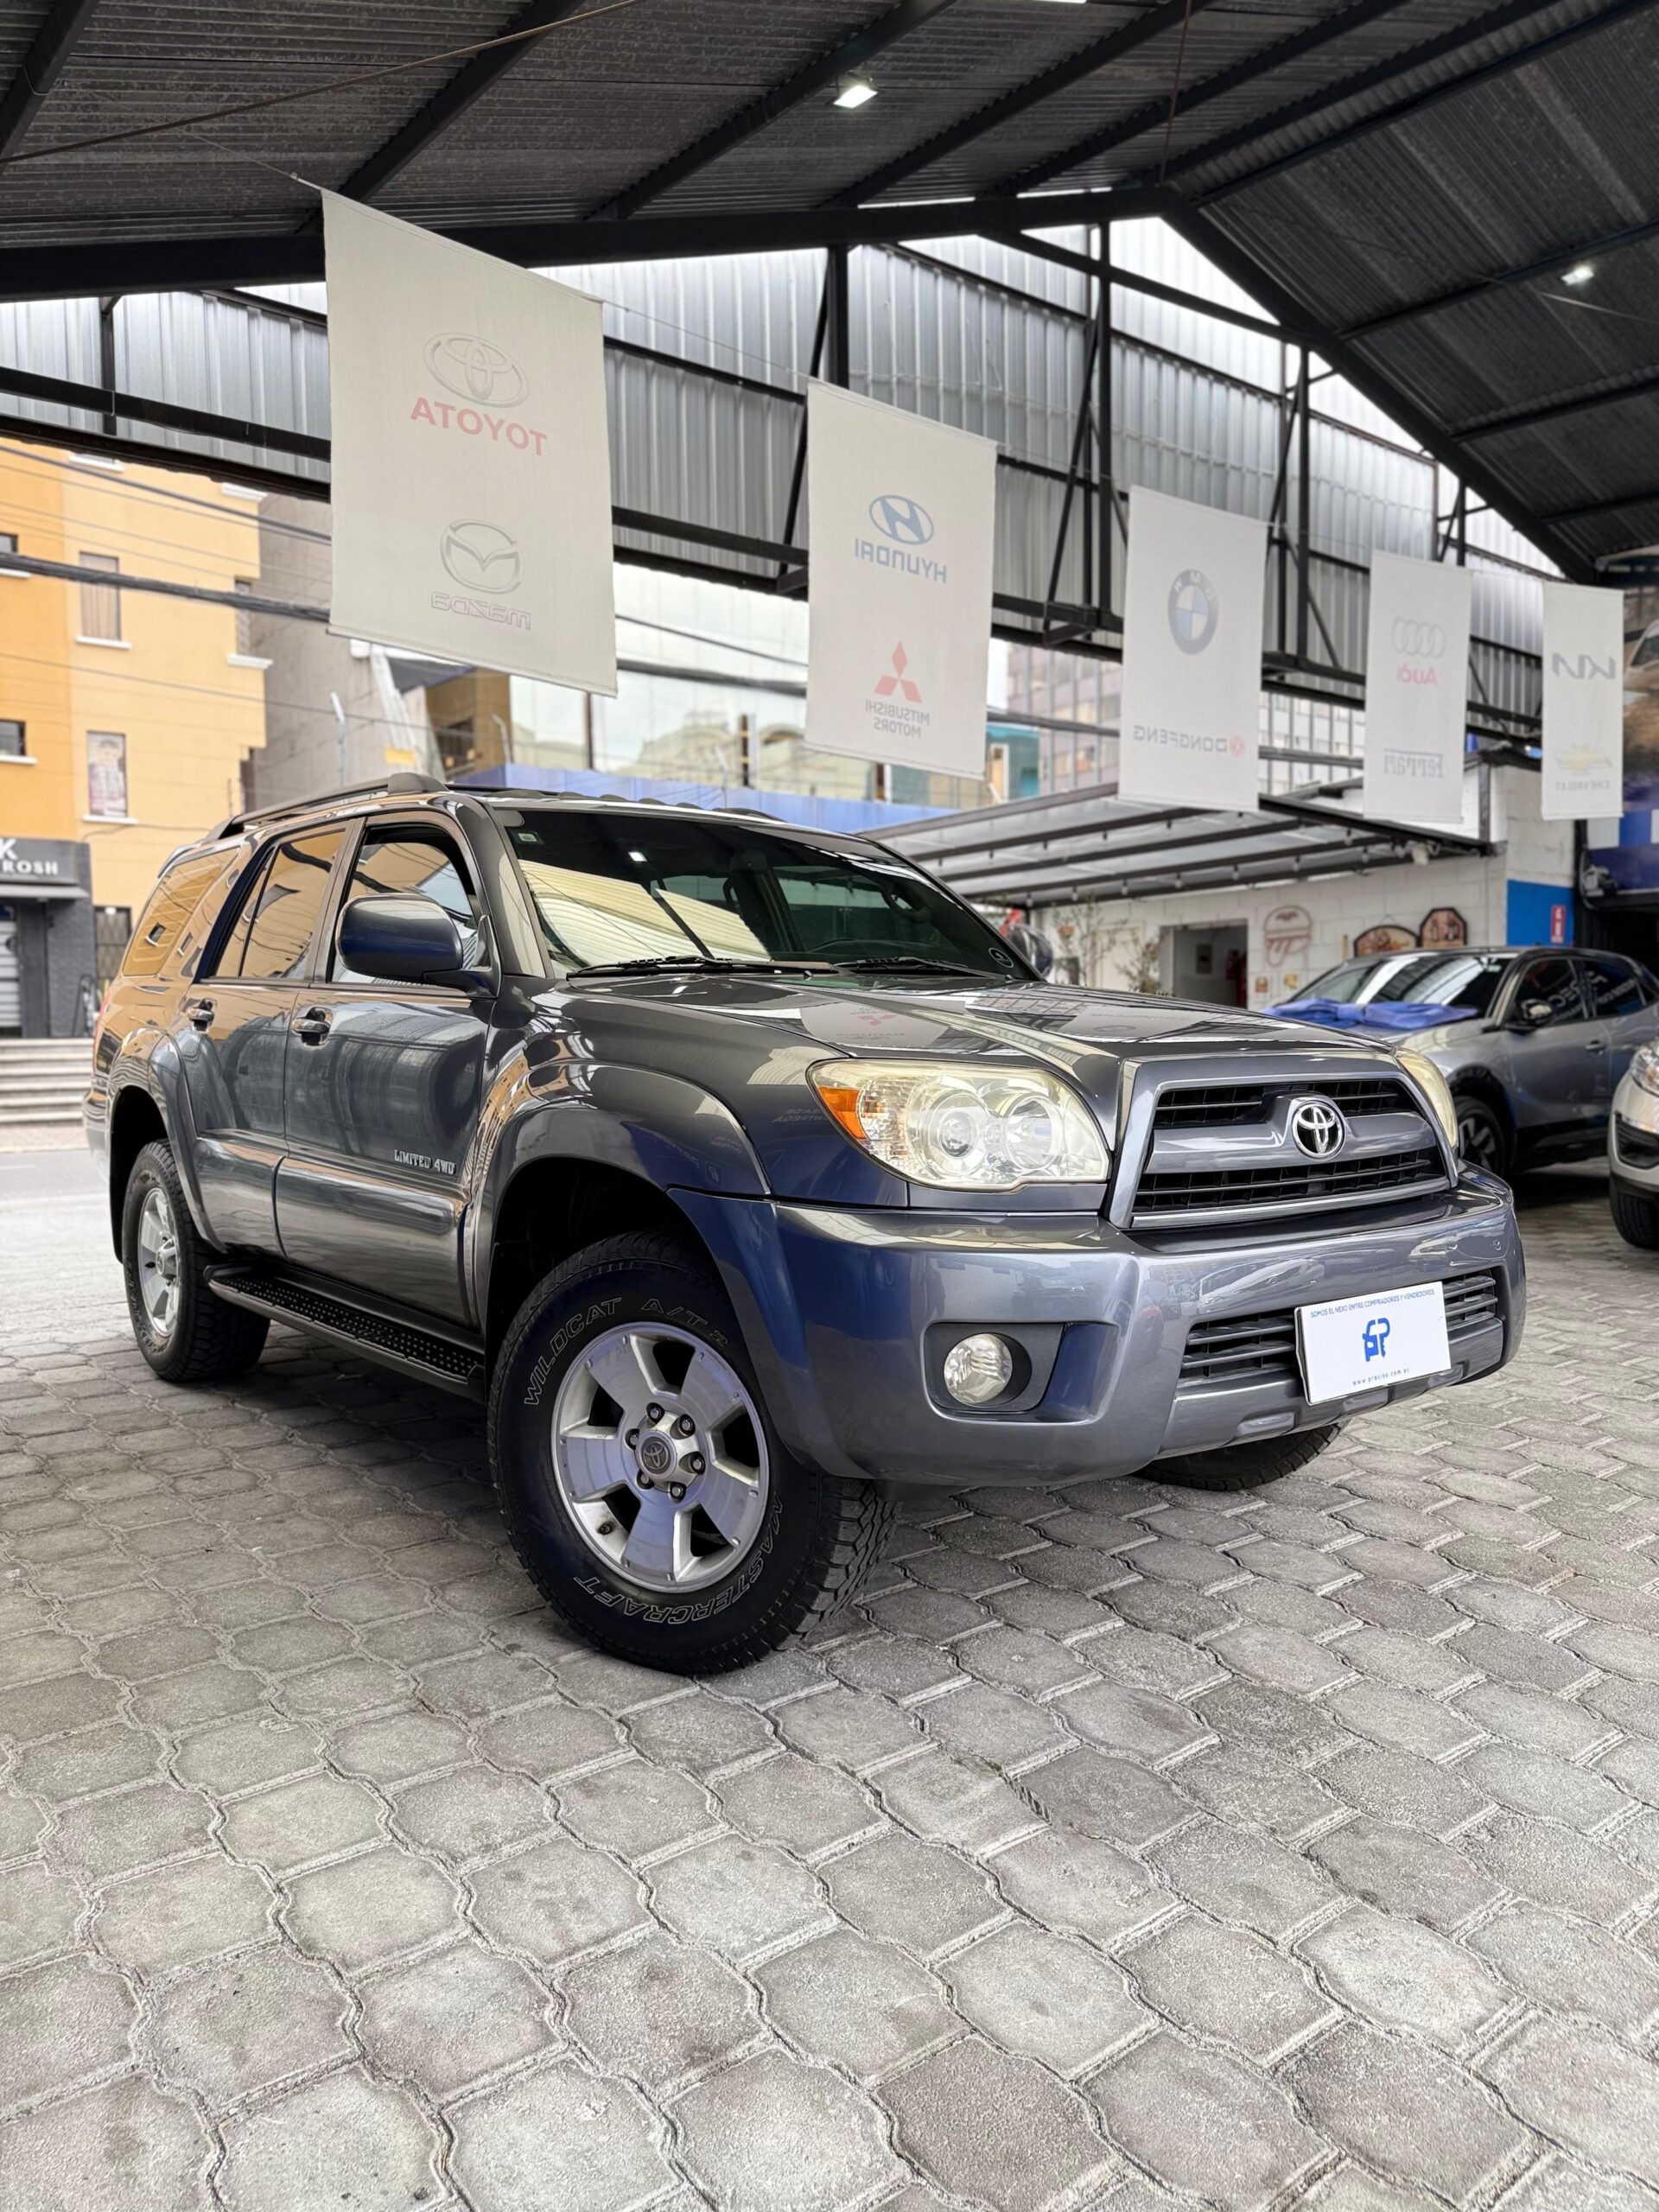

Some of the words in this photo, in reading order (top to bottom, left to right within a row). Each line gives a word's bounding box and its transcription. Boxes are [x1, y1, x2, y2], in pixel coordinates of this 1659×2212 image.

[394, 1149, 431, 1168] LIMITED
[434, 1159, 455, 1174] 4WD
[1310, 1309, 1328, 1318] SOMOS
[1335, 1305, 1348, 1313] NEXO
[1348, 1301, 1364, 1311] ENTRE
[1364, 1295, 1400, 1307] COMPRADORES
[1404, 1288, 1434, 1300] VENDEDORES
[524, 1297, 622, 1406] WILDCAT
[640, 1298, 709, 1328] A/T
[573, 1491, 784, 1625] MASTERCRAFT
